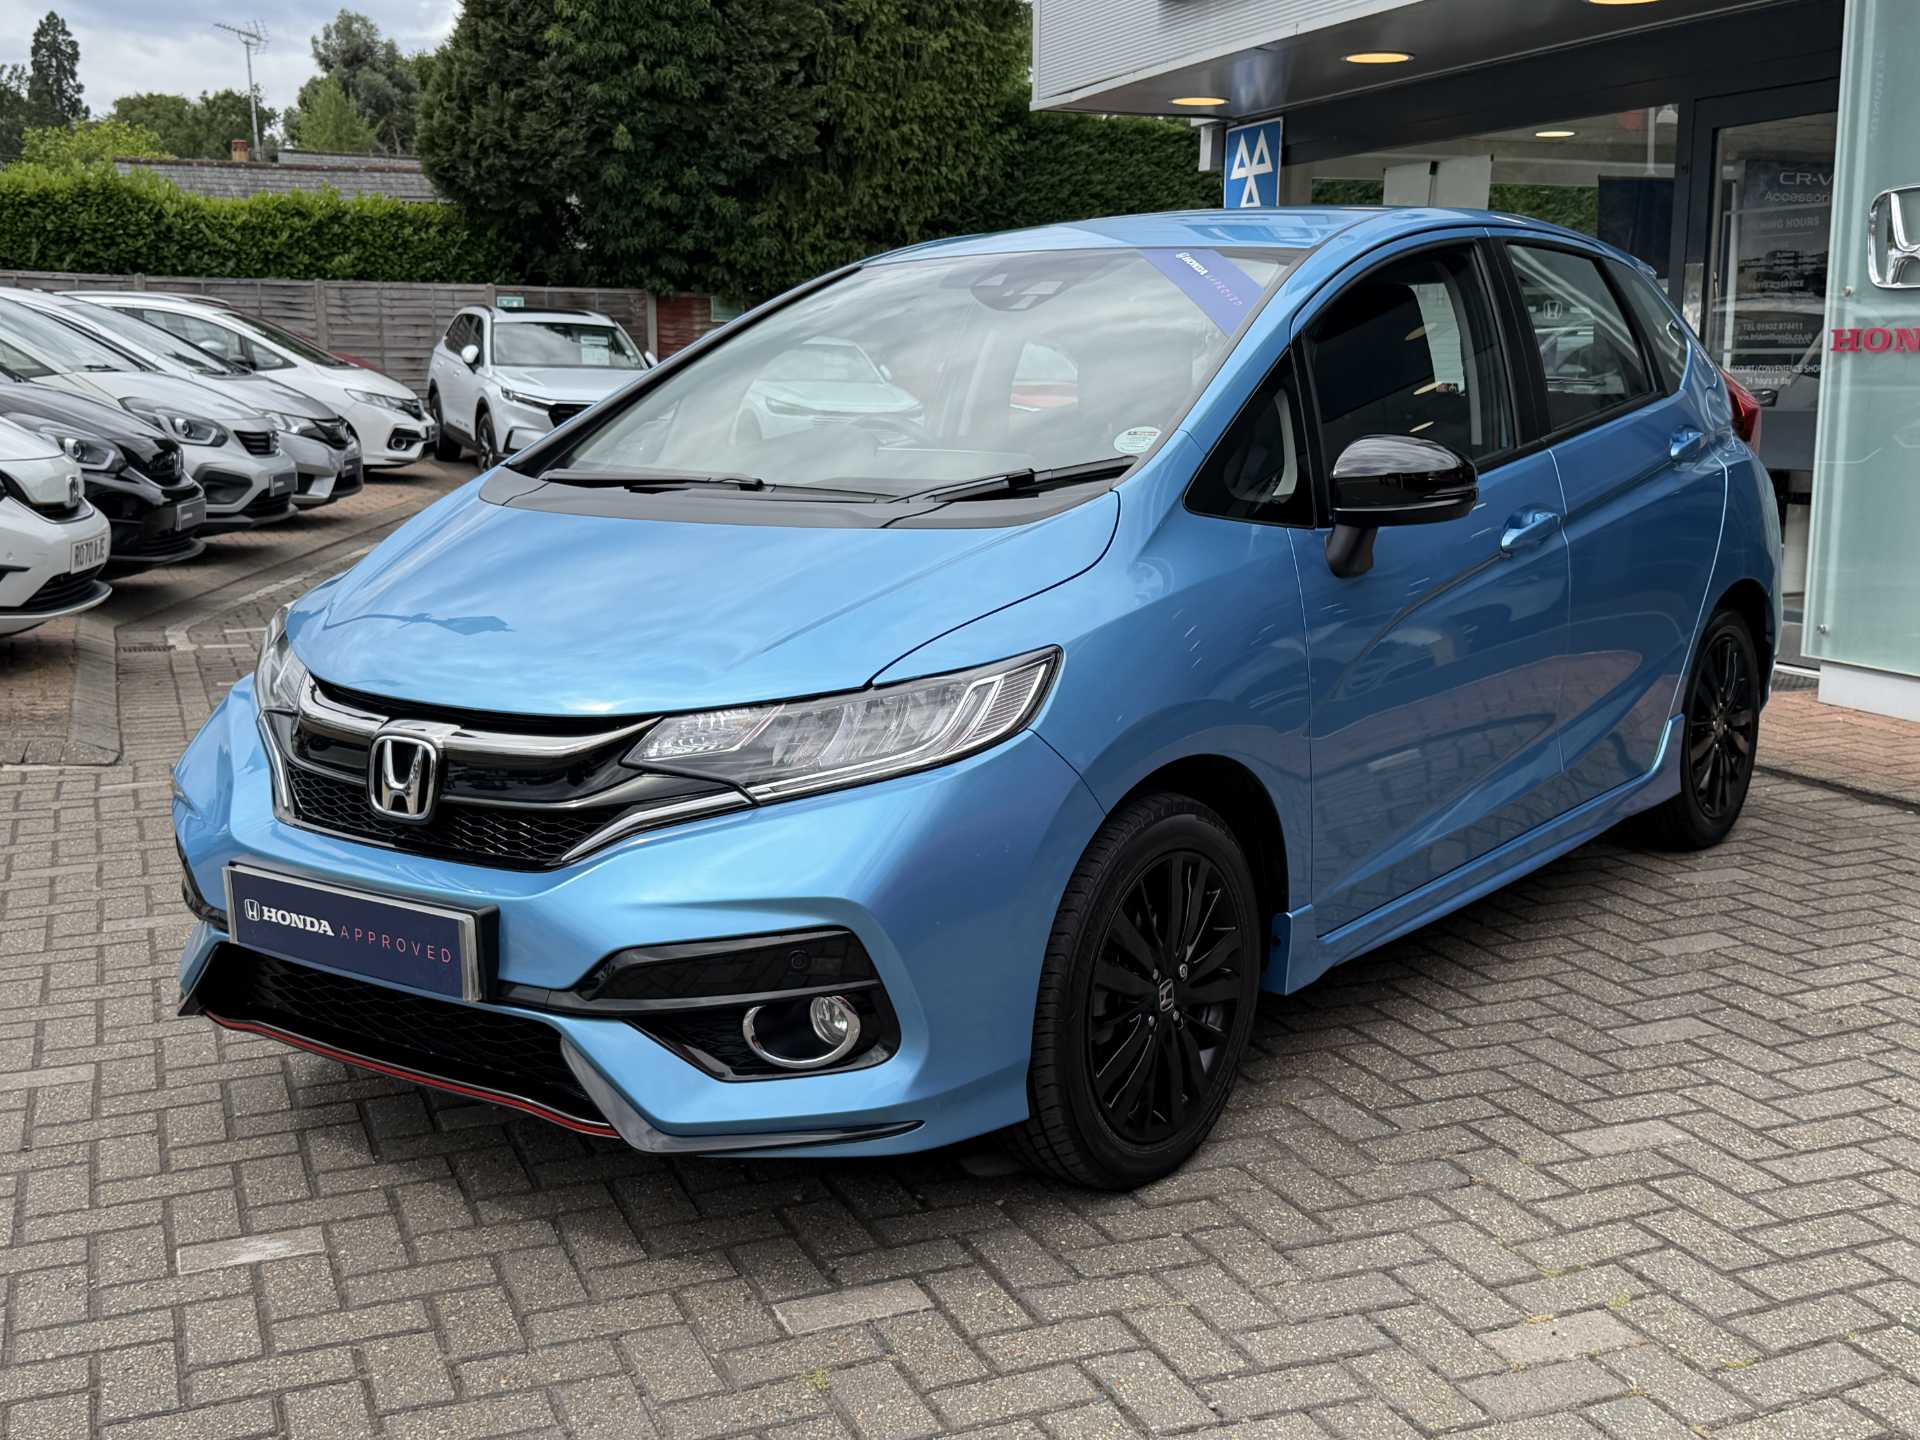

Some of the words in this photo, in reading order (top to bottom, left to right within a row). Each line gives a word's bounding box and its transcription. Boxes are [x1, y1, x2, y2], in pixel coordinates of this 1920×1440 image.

[1830, 326, 1920, 353] HON
[261, 906, 334, 937] HONDA
[340, 925, 452, 964] APPROVED
